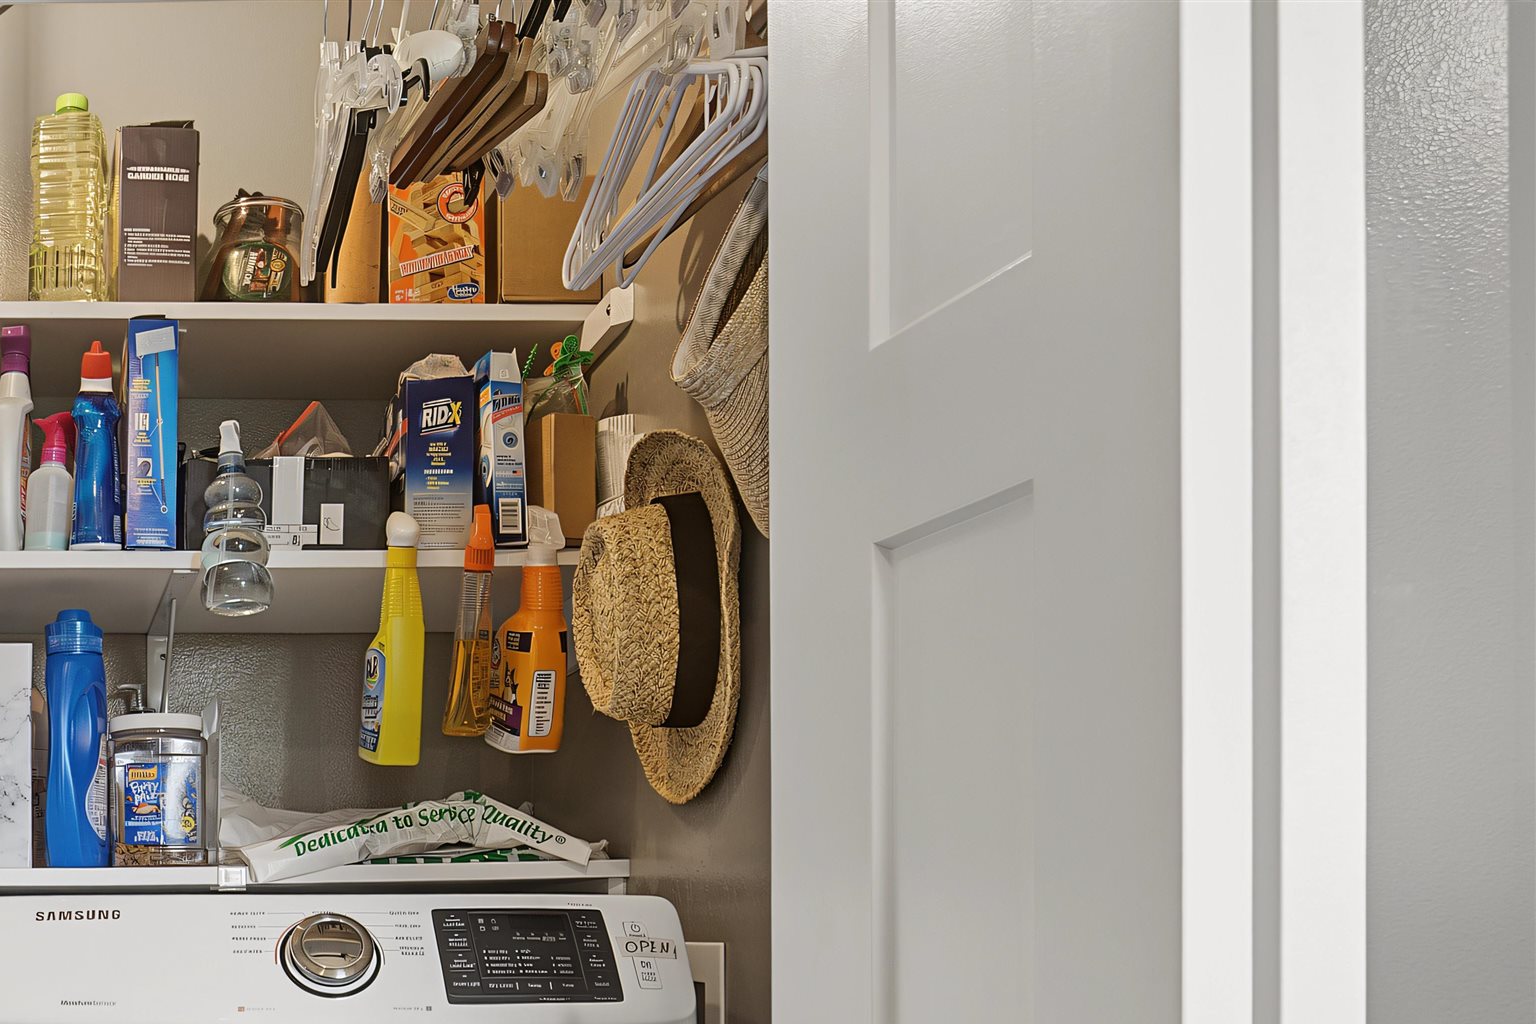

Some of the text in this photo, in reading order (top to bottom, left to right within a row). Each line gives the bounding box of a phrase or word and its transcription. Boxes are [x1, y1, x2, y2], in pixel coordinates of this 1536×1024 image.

[392, 812, 414, 830] to
[35, 909, 121, 921] SAMSUNG
[625, 940, 669, 954] OPEN
